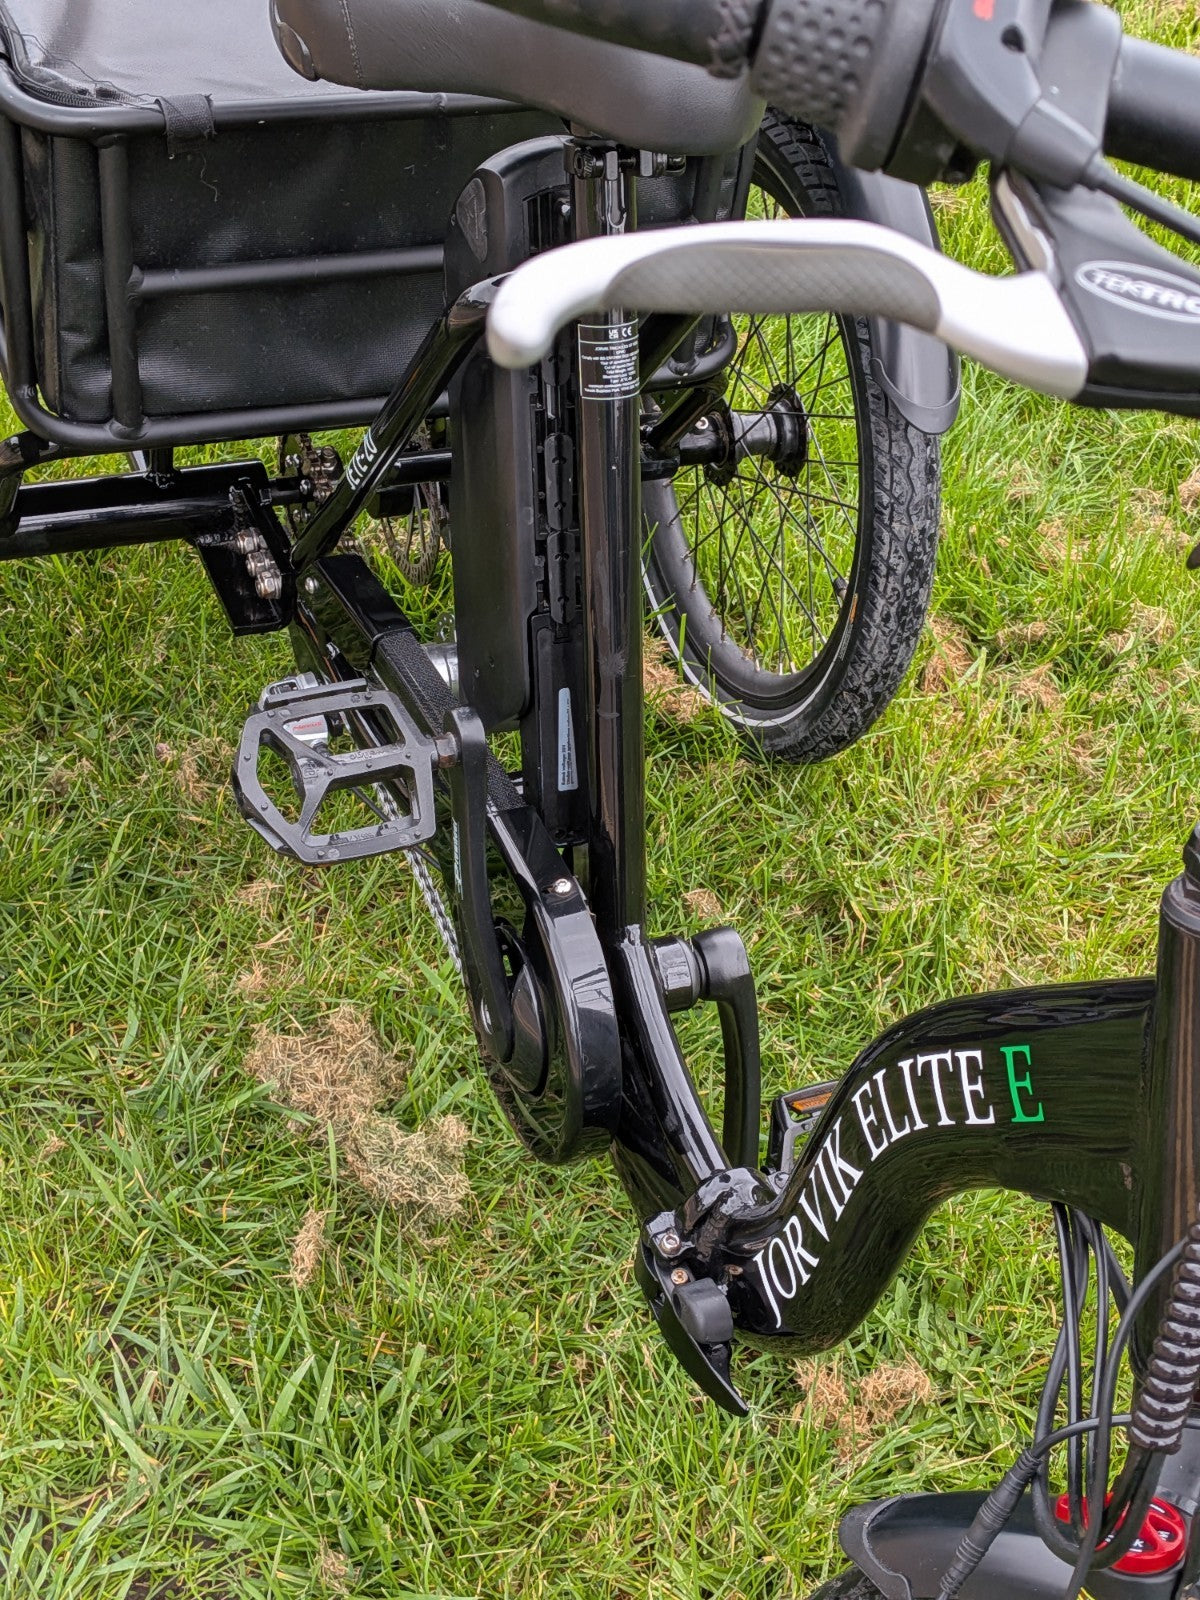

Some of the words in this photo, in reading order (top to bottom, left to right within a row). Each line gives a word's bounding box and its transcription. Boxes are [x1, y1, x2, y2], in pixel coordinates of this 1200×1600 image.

[753, 1117, 864, 1328] JORVIK
[851, 1049, 996, 1161] ELITE
[1000, 1045, 1045, 1122] E
